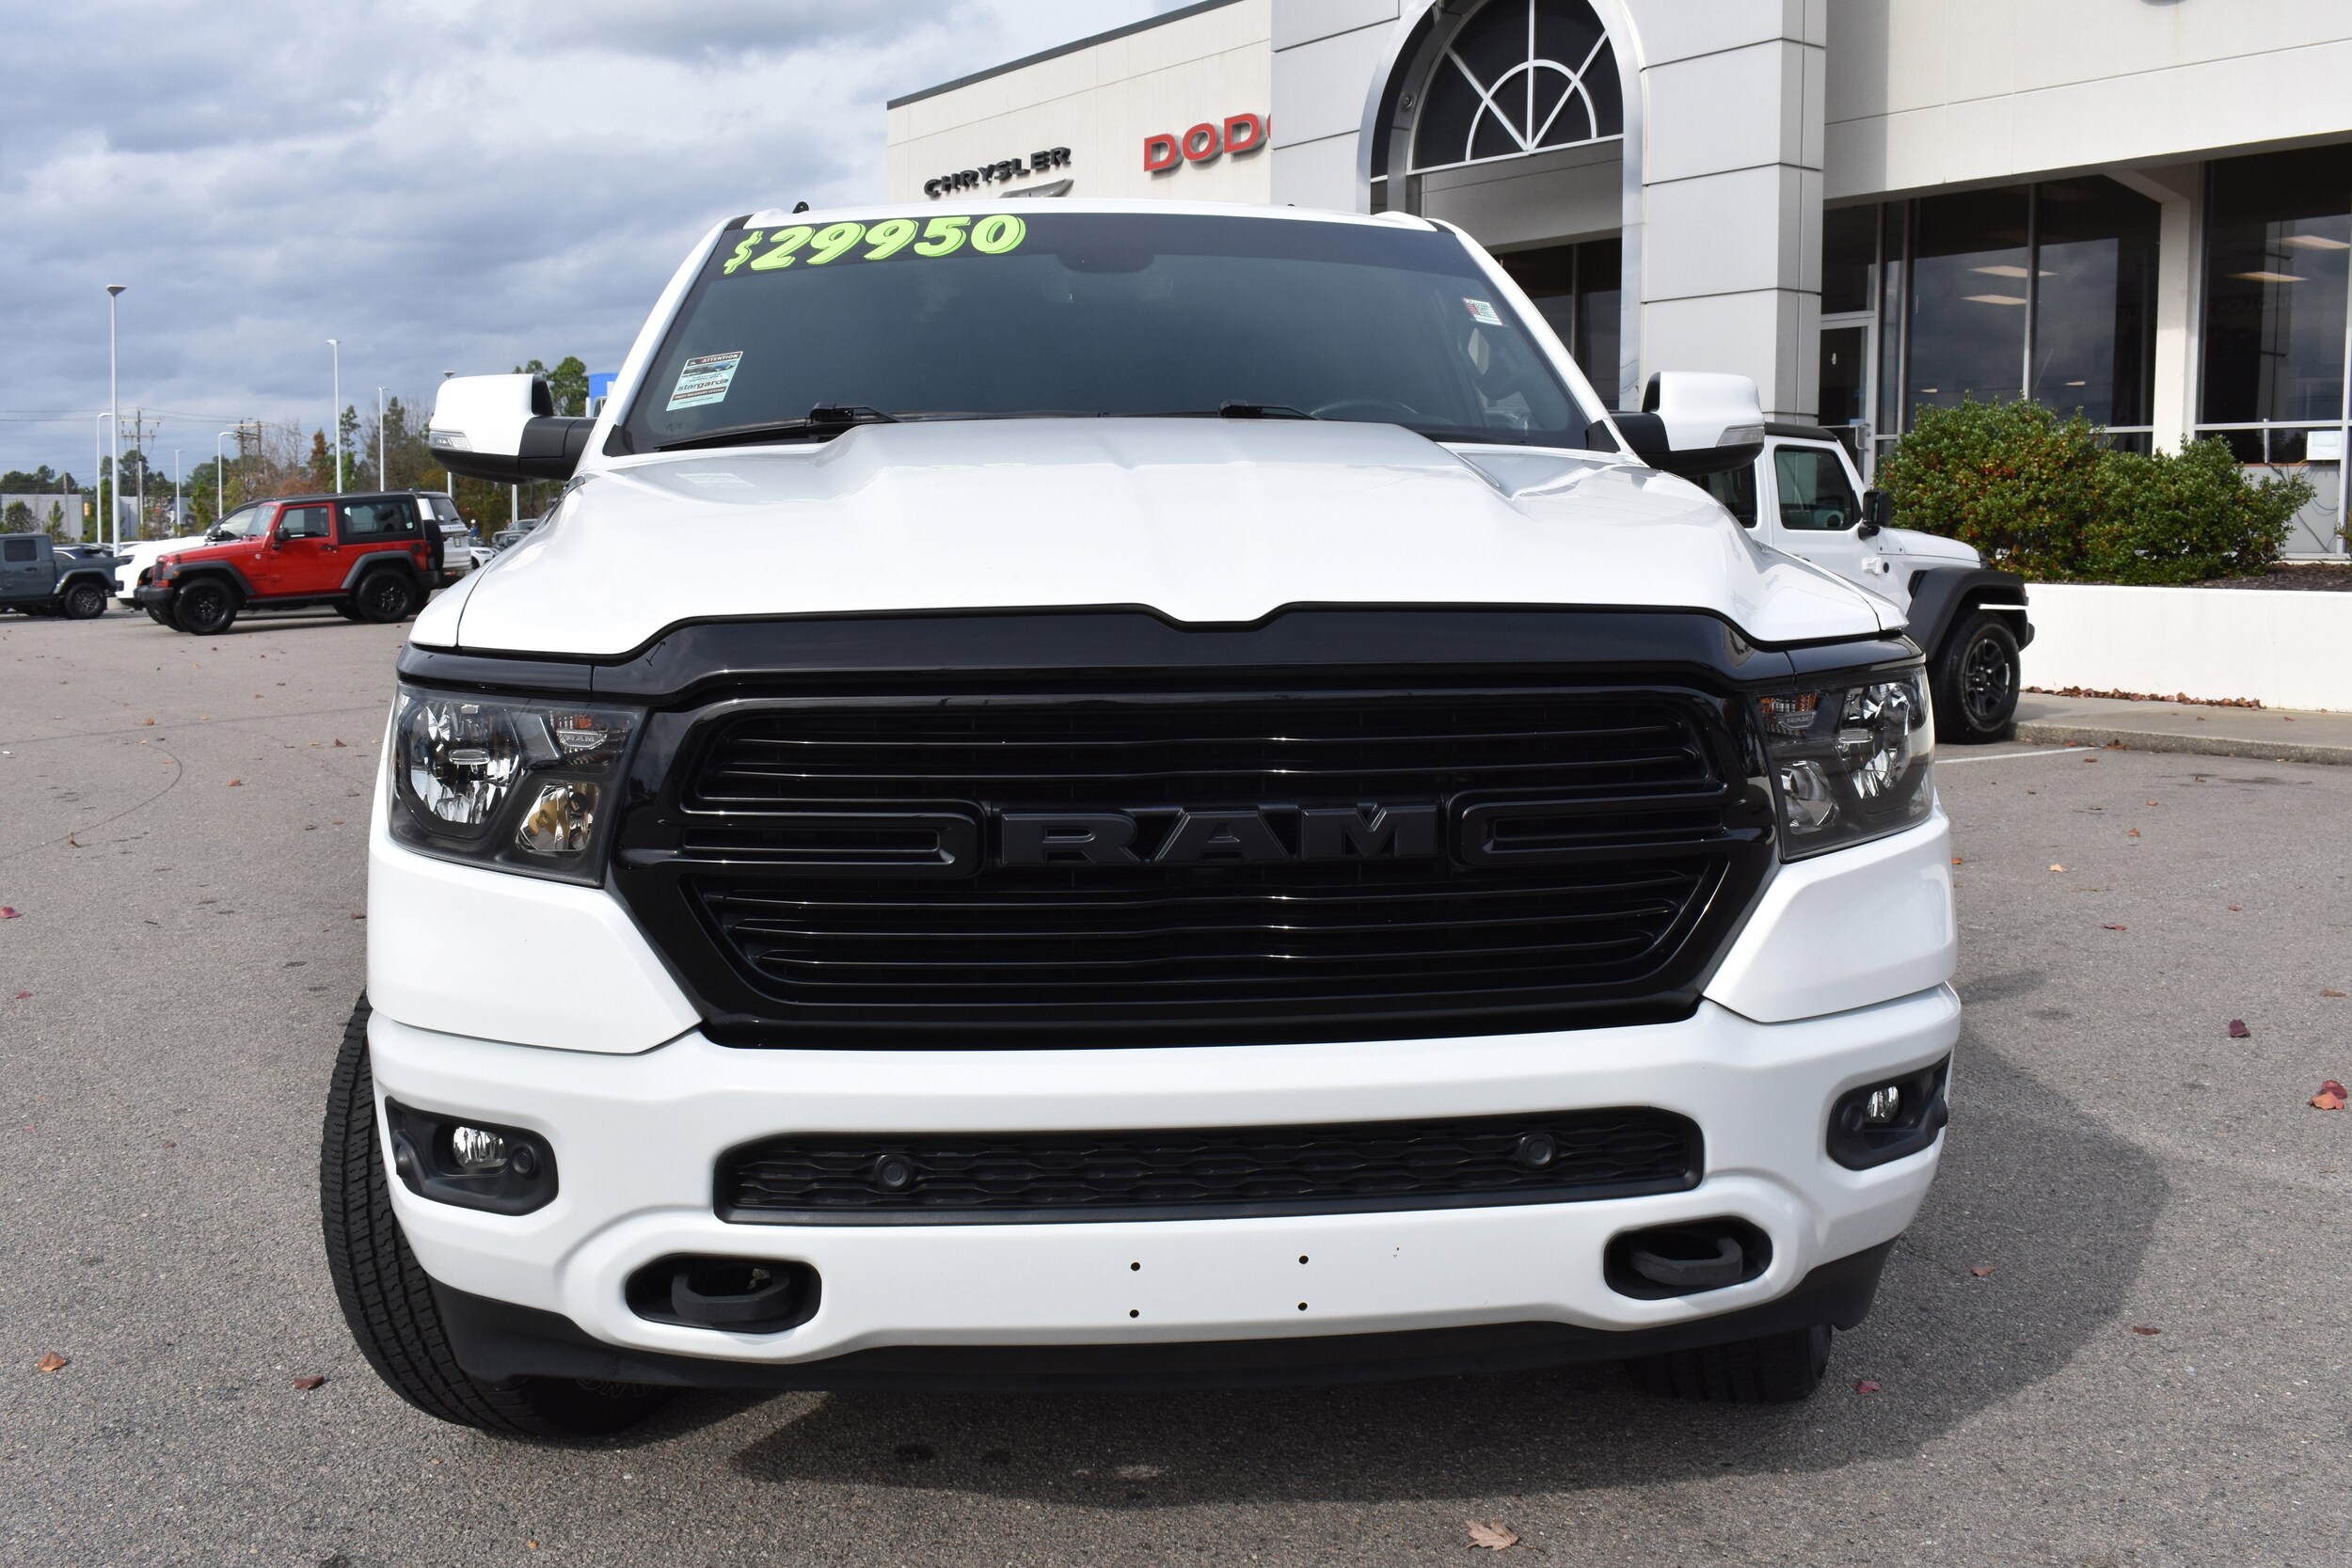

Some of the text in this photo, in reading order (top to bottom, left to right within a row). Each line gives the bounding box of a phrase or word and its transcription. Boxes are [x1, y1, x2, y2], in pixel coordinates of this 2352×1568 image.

[924, 147, 1072, 197] CHRYSLER
[1144, 113, 1271, 173] DOD
[723, 214, 1025, 275] $29950
[702, 353, 739, 363] ATTENTION
[1002, 804, 1438, 865] RAM
